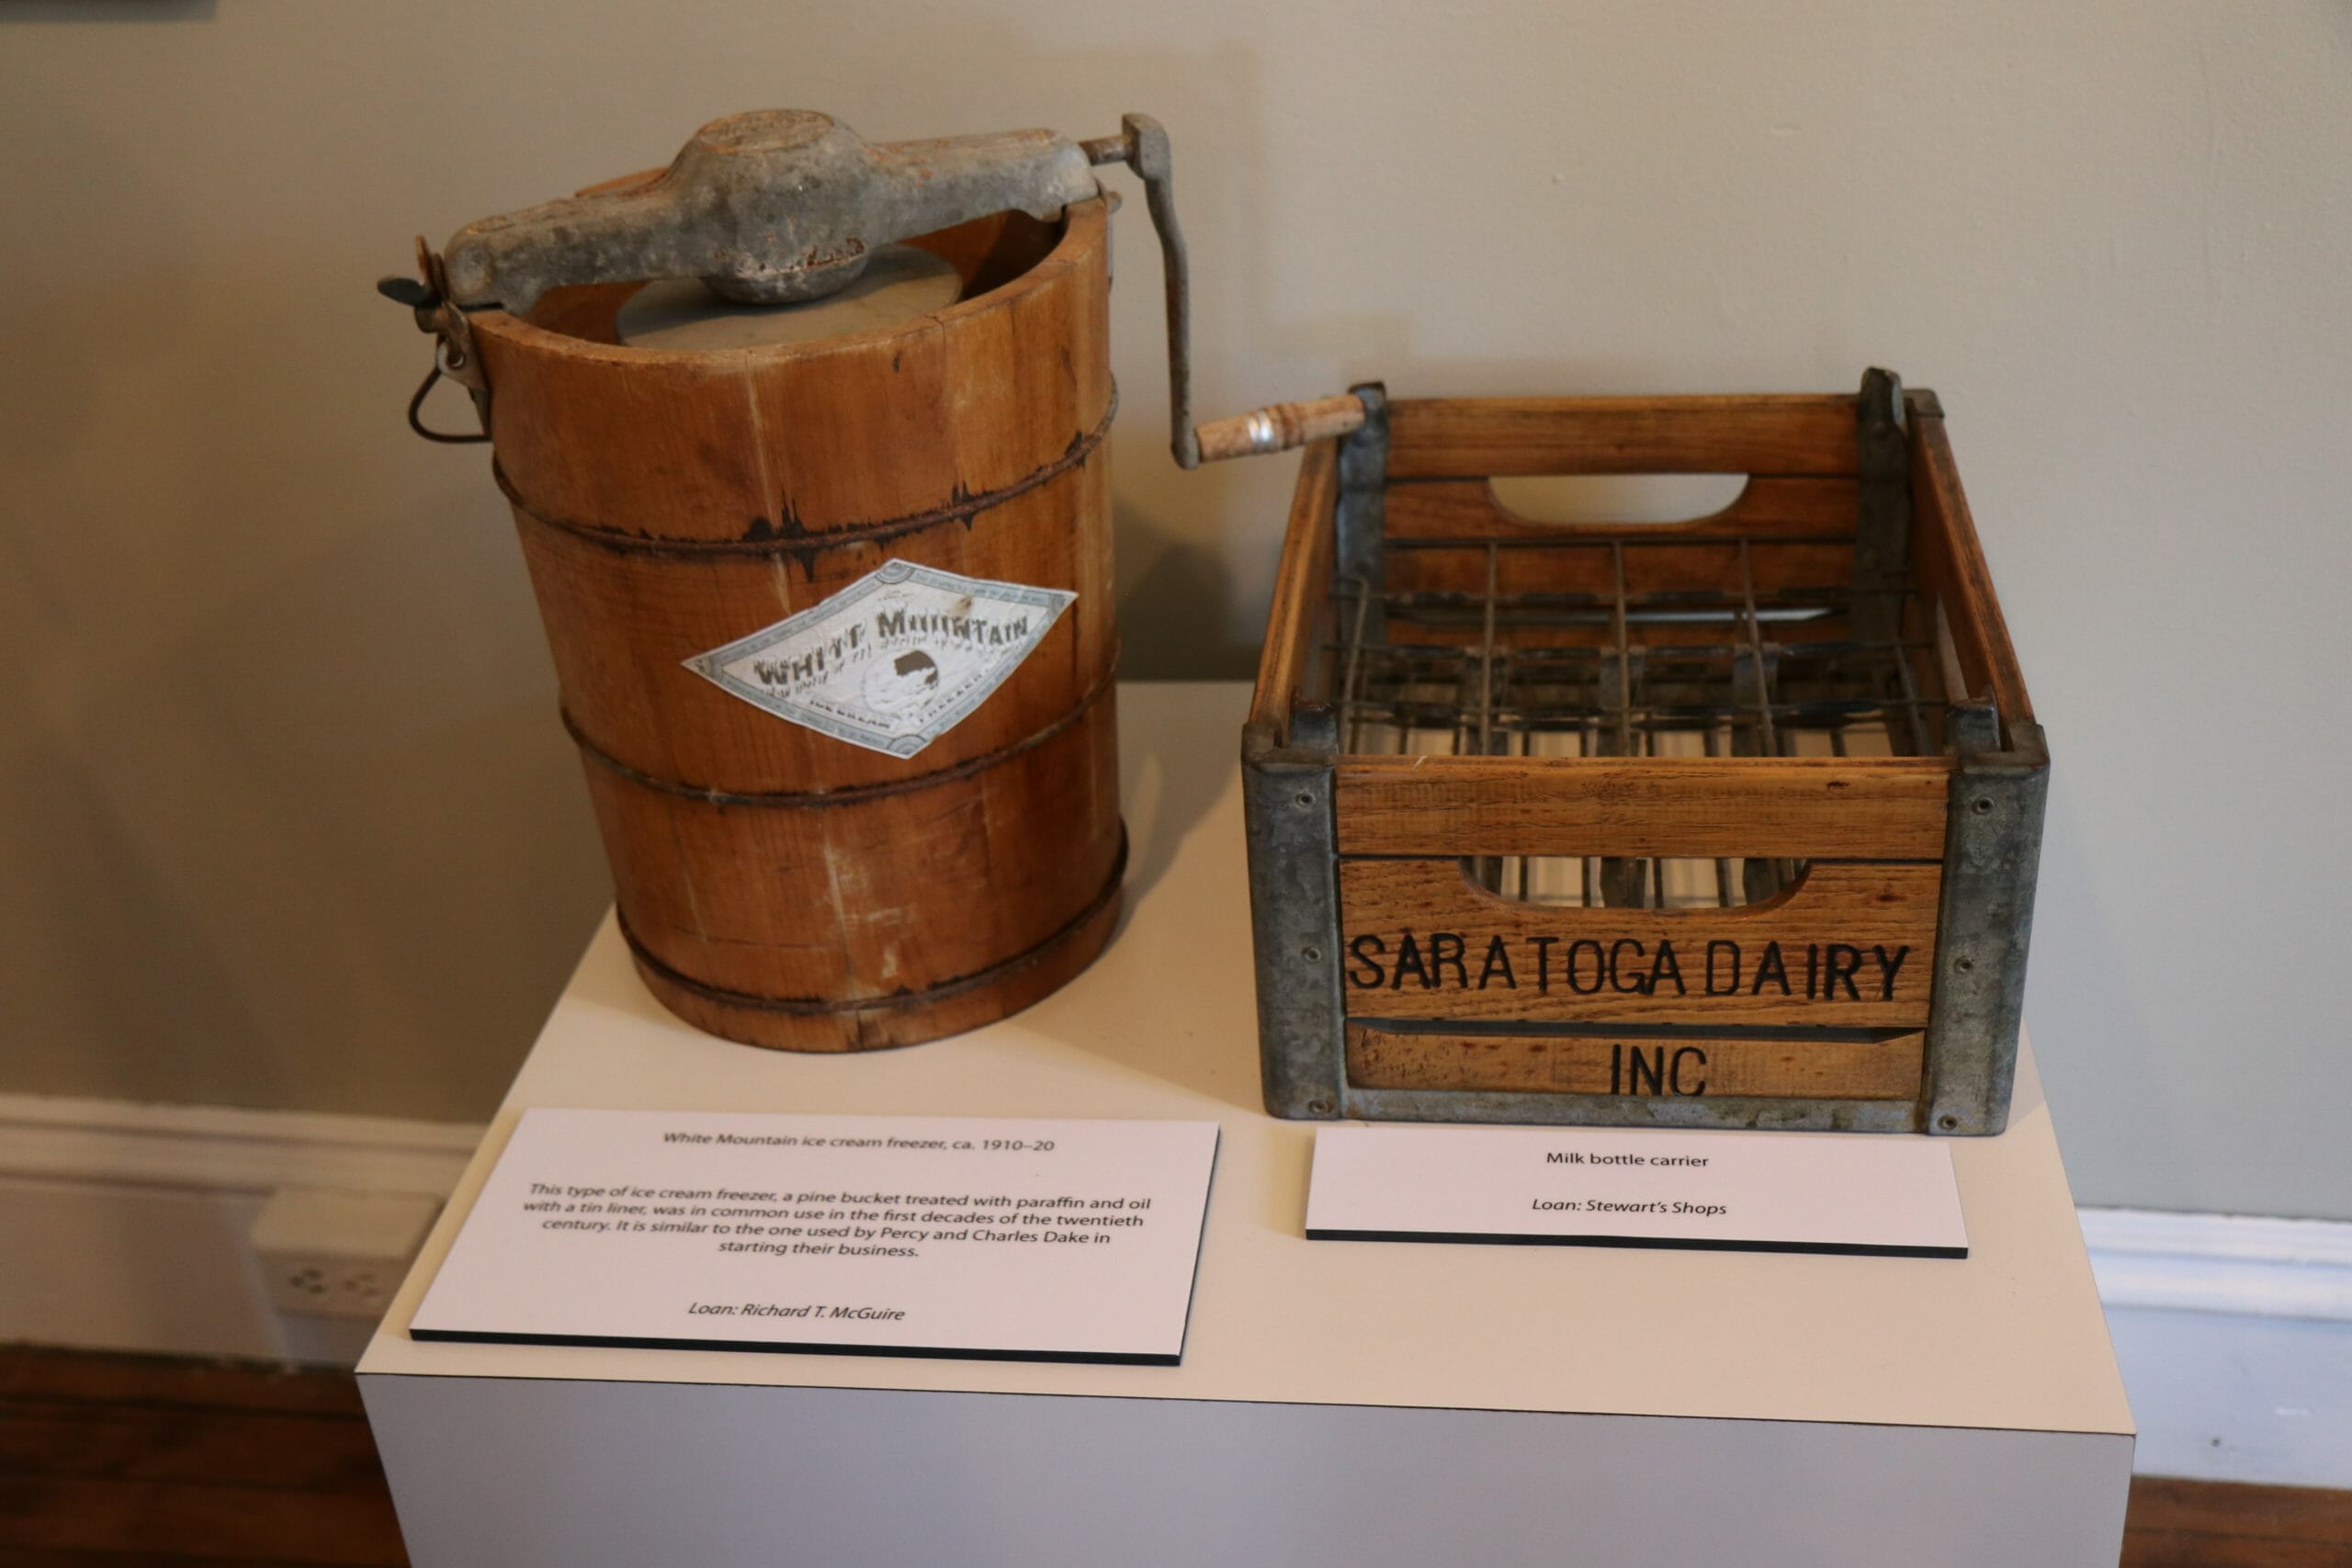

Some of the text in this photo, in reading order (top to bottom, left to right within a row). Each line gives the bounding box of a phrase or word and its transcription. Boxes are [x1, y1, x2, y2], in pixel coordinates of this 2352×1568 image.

[1349, 931, 1910, 1001] SARATOGA DAIRY
[1610, 1043, 1707, 1096] INC
[662, 1131, 714, 1145] White
[715, 1132, 798, 1146] Mountain
[800, 1136, 827, 1147] ice
[829, 1137, 883, 1148] cream
[886, 1136, 947, 1150] freezer,
[951, 1140, 975, 1150] ca.
[1545, 1151, 1710, 1168] Milk bottle carrier
[530, 1181, 1152, 1211] This type of ice cream freezer, a pine bucket treated with paraffin and oil
[523, 1200, 1145, 1227] with a tin liner, was in common use in the first decades of the twentieth
[1531, 1198, 1582, 1212] Loan:
[1670, 1200, 1727, 1218] Shops
[541, 1219, 1111, 1245] century. It is similar to the one used by Percy and Charles Dake in
[718, 1240, 920, 1258] starting their business.
[687, 1301, 906, 1321] Loan: Richard T. McGuire
